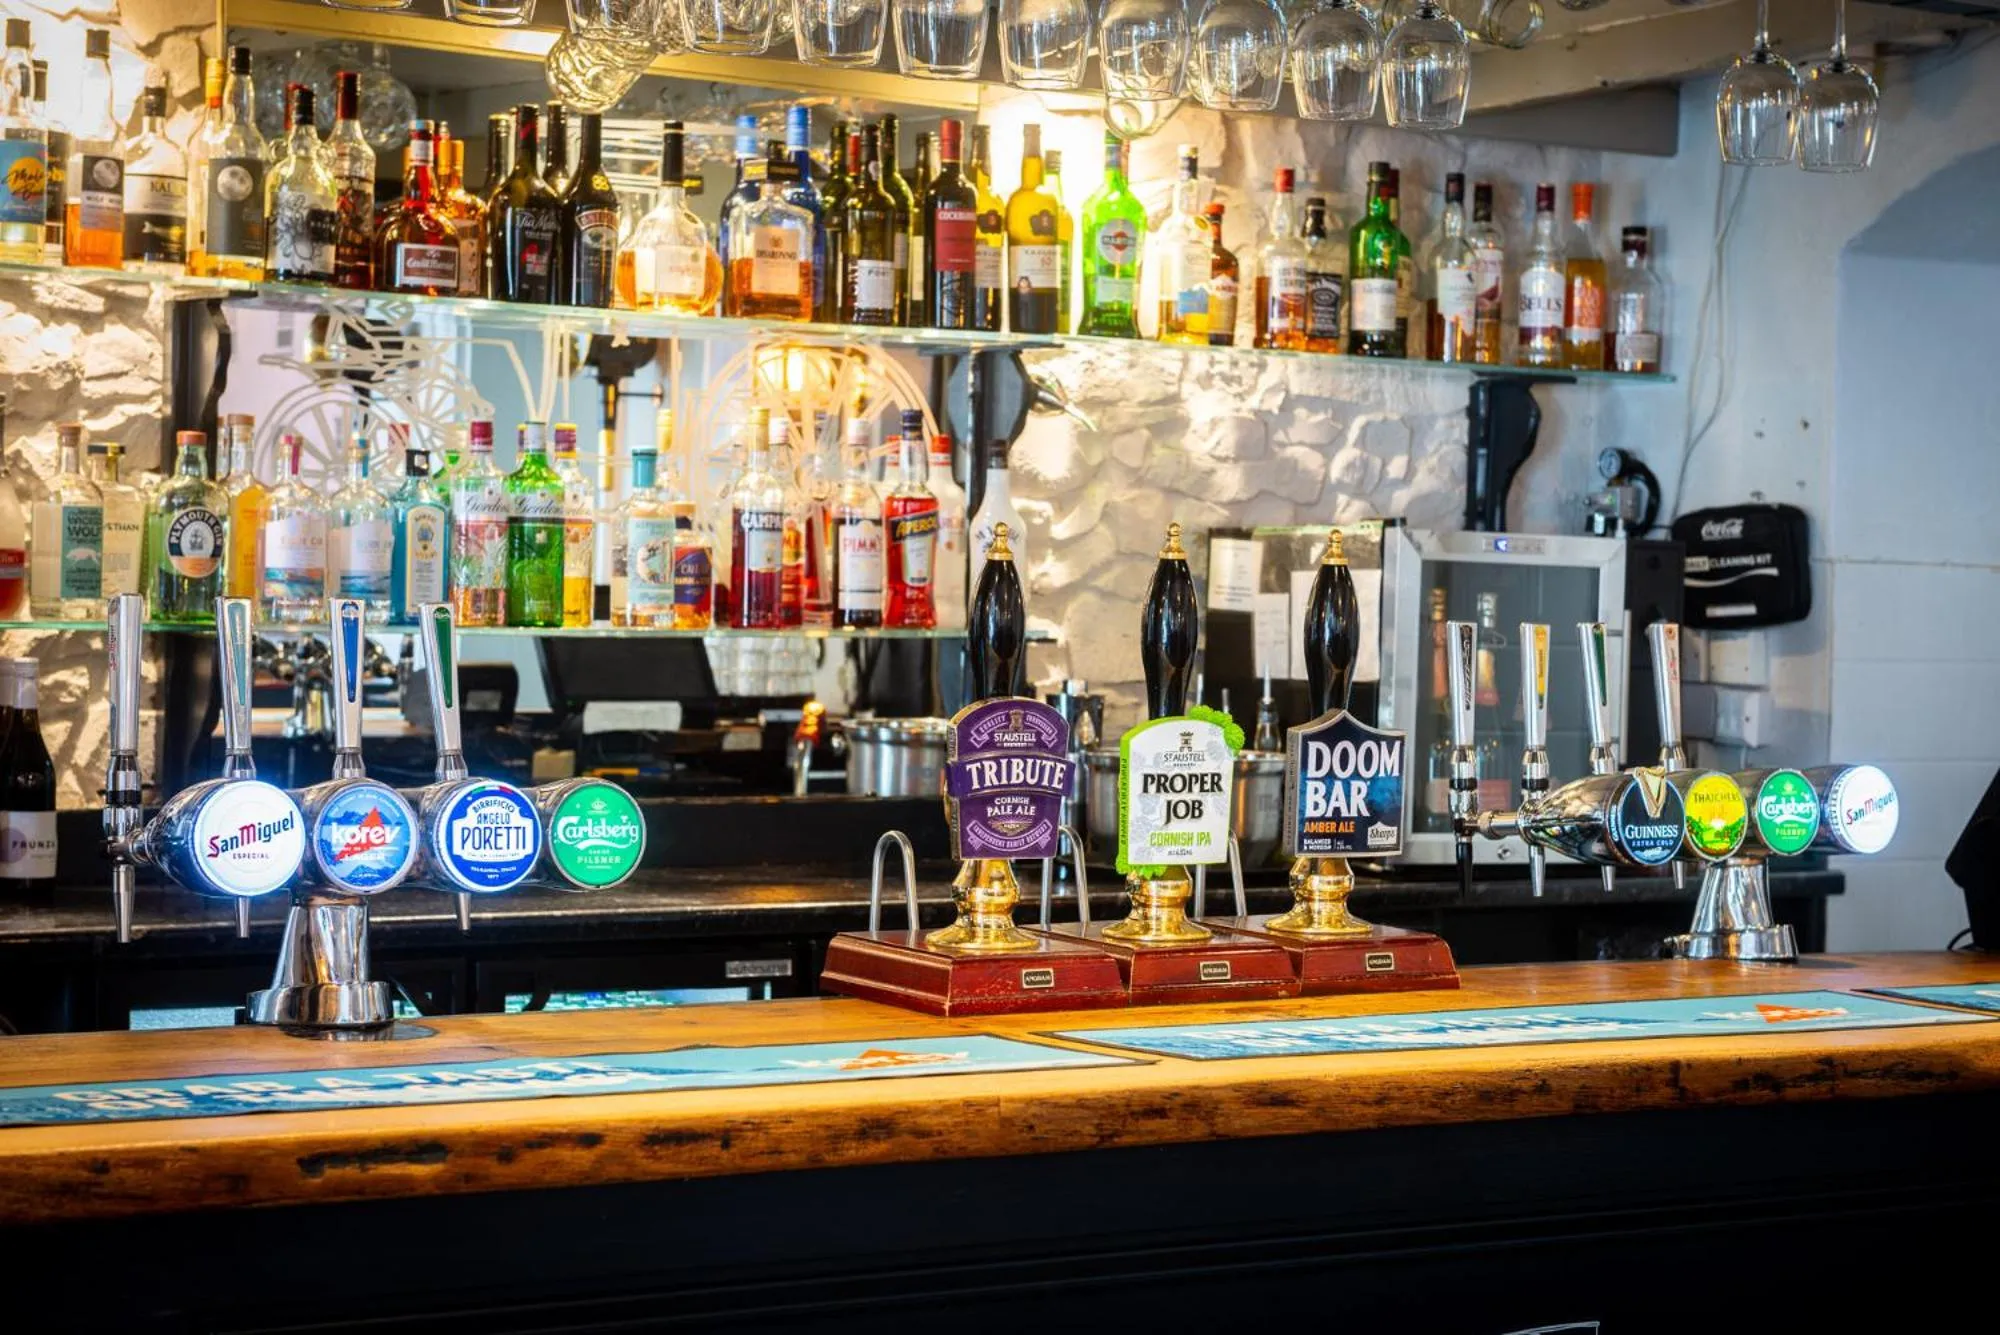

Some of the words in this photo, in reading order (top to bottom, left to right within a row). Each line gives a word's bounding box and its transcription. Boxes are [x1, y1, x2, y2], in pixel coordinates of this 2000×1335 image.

[170, 511, 216, 544] PLYMOUTH
[1307, 740, 1401, 779] DOOM
[966, 758, 1067, 790] TRIBUTE
[1142, 772, 1223, 794] PROPER
[472, 799, 516, 814] BIRRIFICIO
[994, 796, 1030, 805] CORNISH
[1304, 780, 1370, 818] BAR
[1761, 792, 1817, 820] Carlsberg
[987, 805, 1013, 817] PALE
[1015, 805, 1036, 816] ALE
[1164, 799, 1204, 825] JOB
[476, 813, 511, 825] ANGELO
[557, 815, 640, 848] Carlsberg
[1303, 821, 1337, 833] AMBER
[1338, 821, 1355, 833] ALE
[1624, 824, 1679, 839] GUINNESS
[461, 826, 527, 851] PORETTI
[1150, 832, 1194, 847] CORNISH
[1196, 832, 1211, 847] IPA
[1655, 839, 1674, 847] COLD
[232, 852, 270, 860] ESPECIAL
[577, 855, 622, 864] PILSNER
